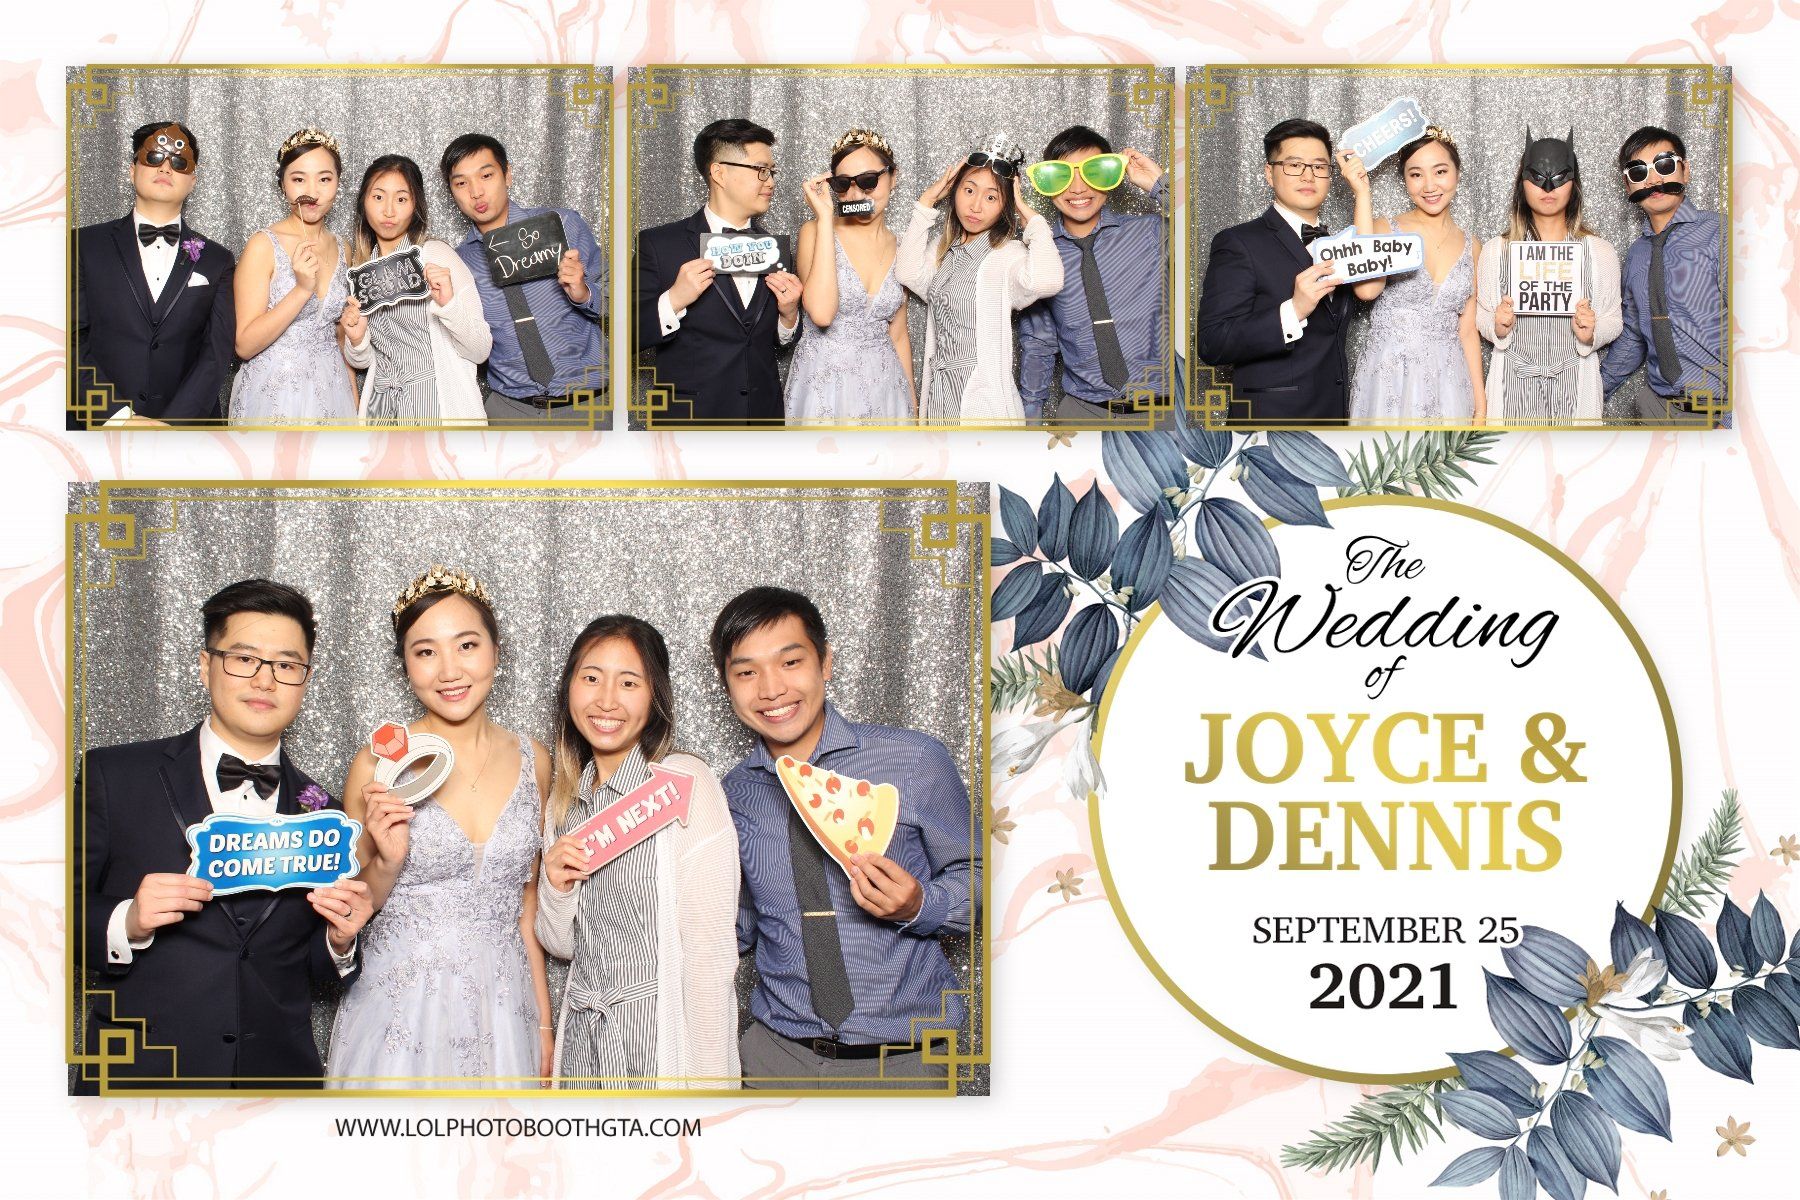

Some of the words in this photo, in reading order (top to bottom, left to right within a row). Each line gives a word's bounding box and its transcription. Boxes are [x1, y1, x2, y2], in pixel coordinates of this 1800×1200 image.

[1352, 108, 1418, 158] CHEERS!
[842, 202, 871, 213] CENSORED
[518, 227, 540, 250] So
[710, 243, 743, 257] HOW
[747, 239, 773, 252] YOU
[494, 242, 563, 279] Dreamy
[1320, 242, 1362, 262] Ohhh
[1373, 239, 1412, 255] Baby
[1519, 245, 1523, 261] I
[1526, 245, 1546, 261] AM
[1549, 245, 1574, 261] THE
[358, 257, 416, 289] GLAM
[1347, 255, 1393, 277] Baby!
[1519, 261, 1573, 280] LIFE
[359, 272, 422, 304] SQUAD
[1519, 281, 1539, 292] OF
[1543, 281, 1573, 292] THE
[1519, 291, 1573, 312] PARTY
[581, 824, 617, 858] I'M
[615, 781, 681, 835] NEXT!
[209, 831, 304, 853] DREAMS
[308, 829, 341, 848] DO
[208, 858, 276, 878] COME
[280, 853, 341, 874] TRUE!
